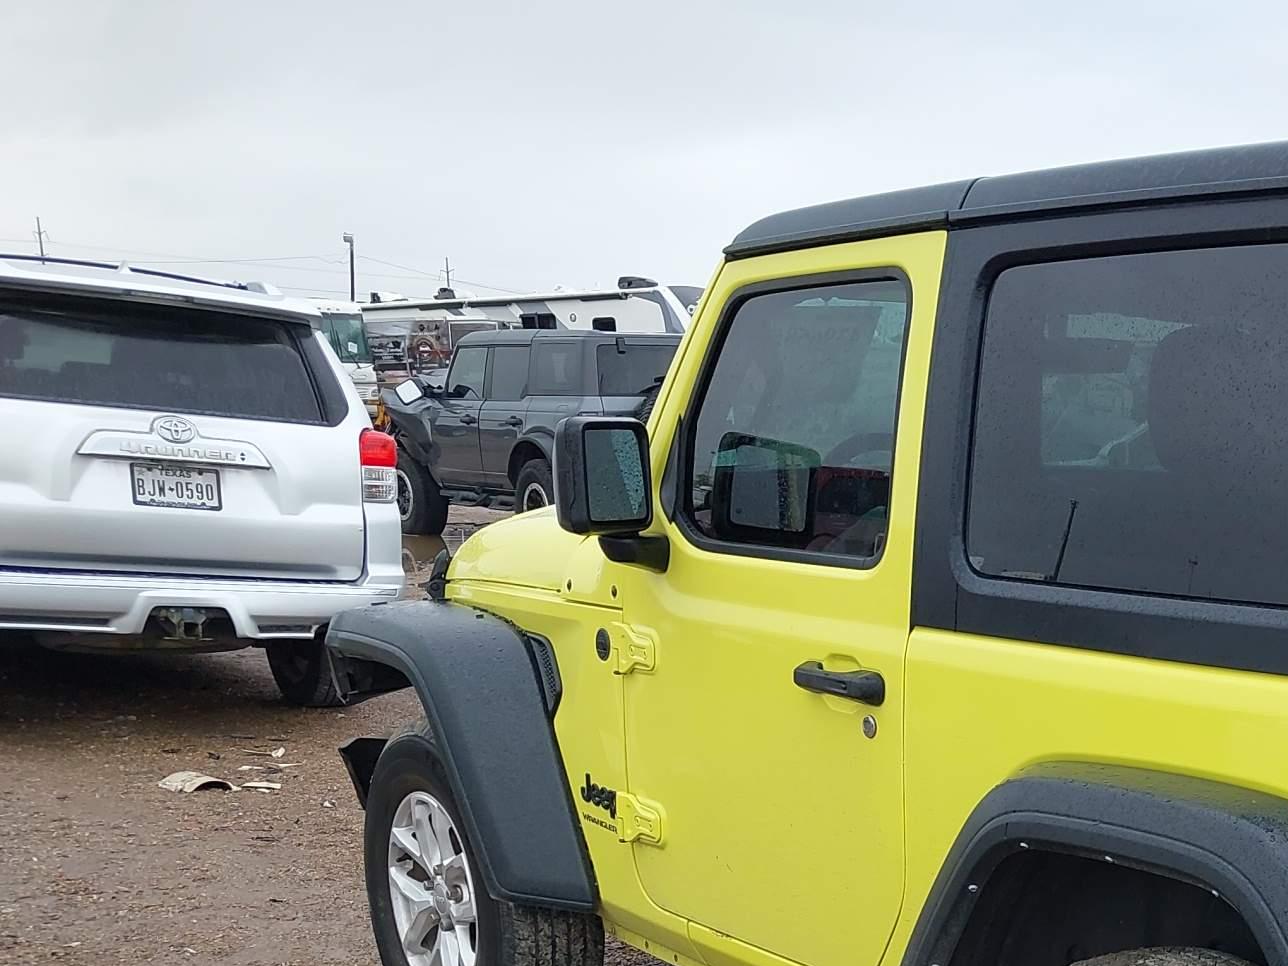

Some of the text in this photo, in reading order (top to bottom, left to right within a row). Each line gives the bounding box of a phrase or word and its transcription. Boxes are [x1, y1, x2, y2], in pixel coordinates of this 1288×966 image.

[158, 467, 192, 479] TEXAS
[580, 772, 617, 820] Jeep
[582, 812, 618, 835] WRANGLER
